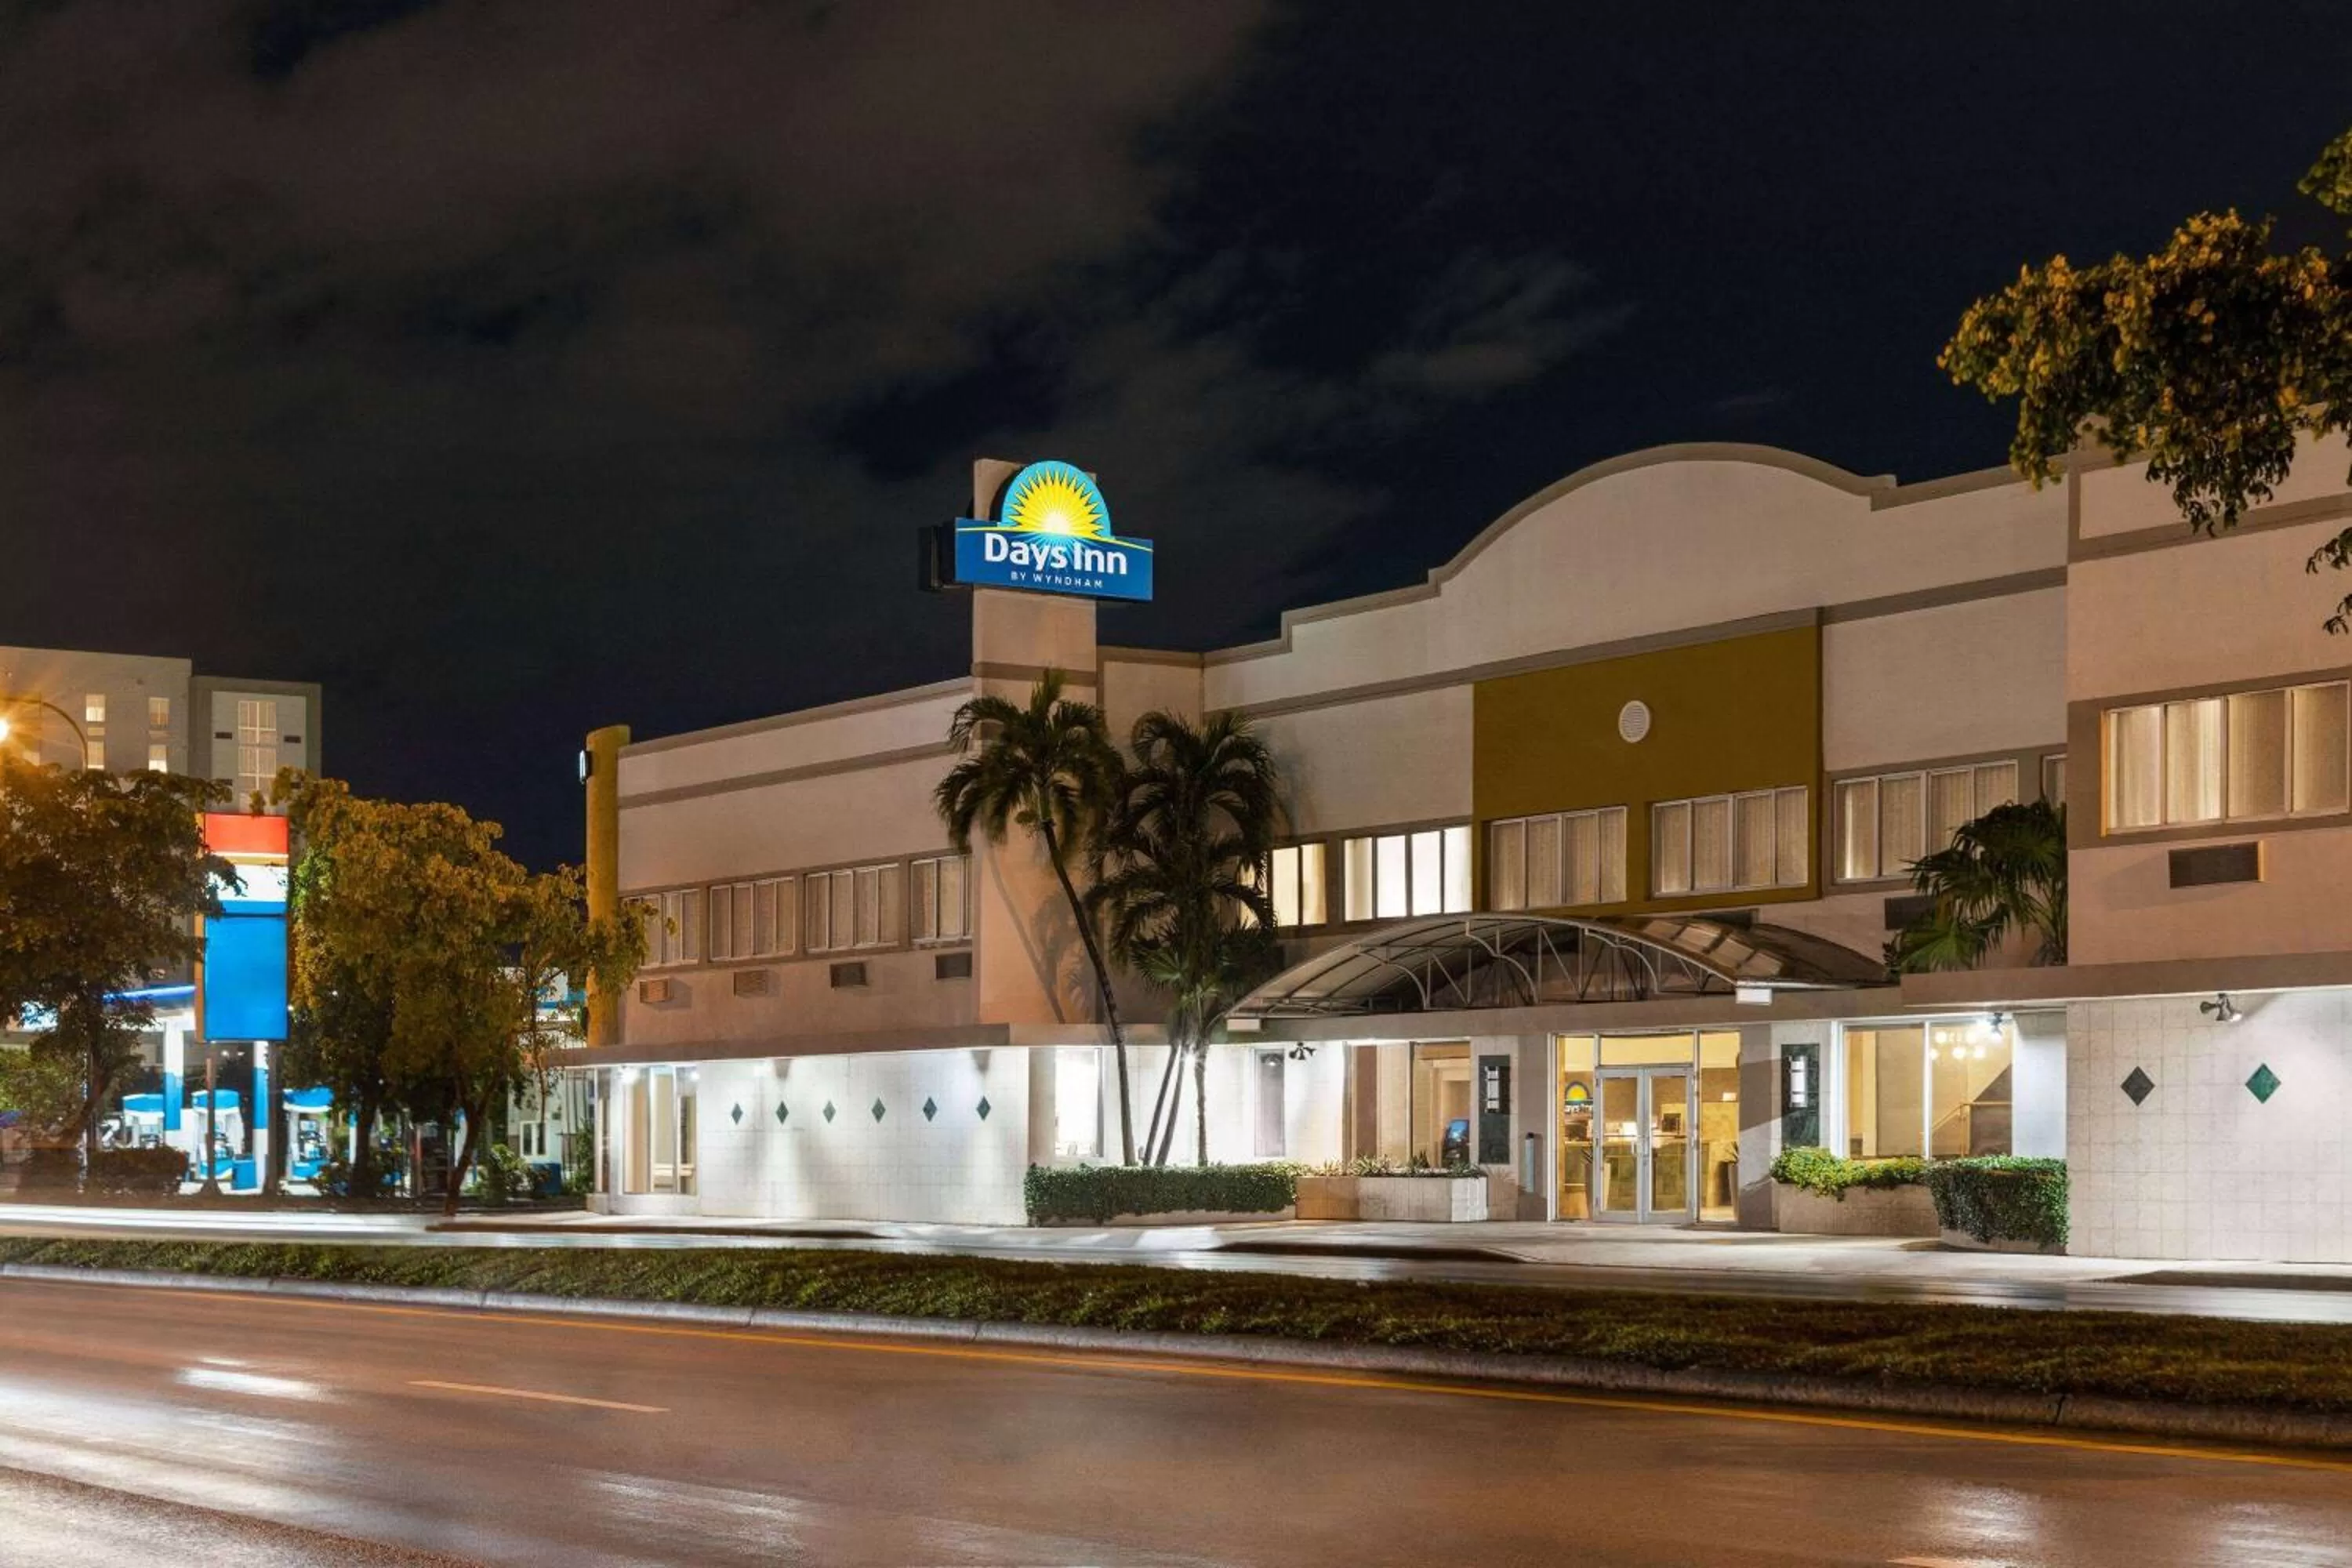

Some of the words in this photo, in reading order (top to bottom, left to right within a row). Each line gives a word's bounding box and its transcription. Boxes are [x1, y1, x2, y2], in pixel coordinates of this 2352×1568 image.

[985, 532, 1068, 571] Days
[1073, 543, 1127, 575] Inn
[1011, 571, 1026, 581] BY
[1033, 573, 1103, 588] WYNDHAM
